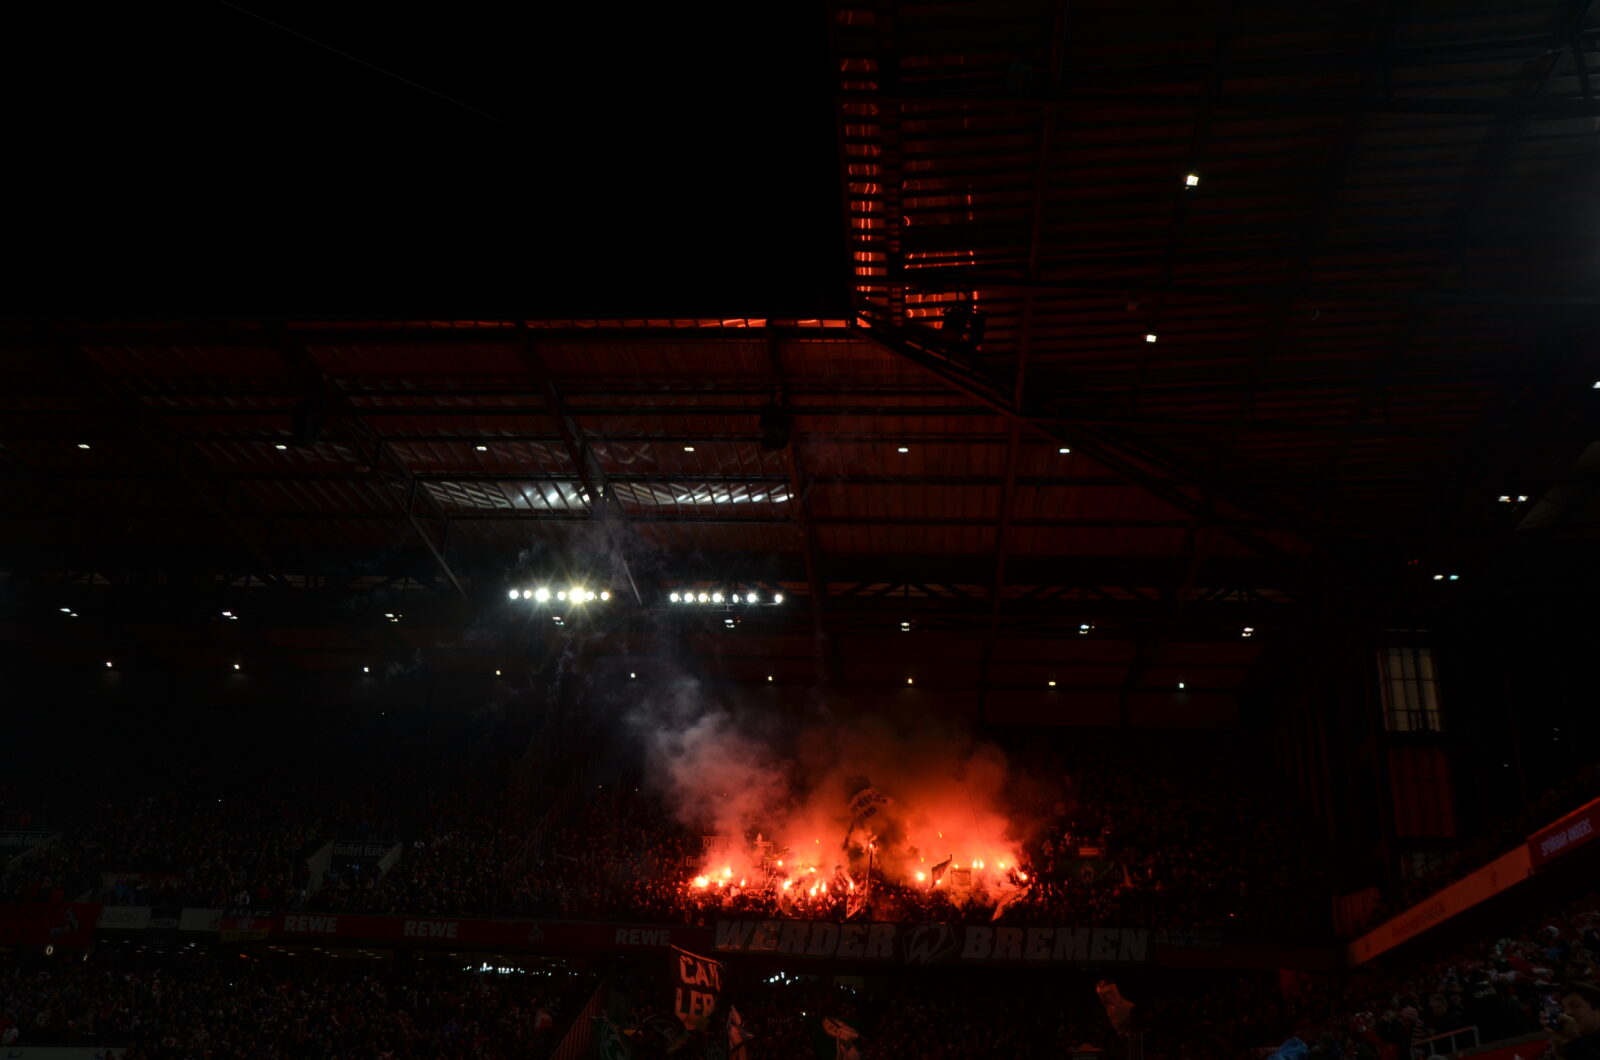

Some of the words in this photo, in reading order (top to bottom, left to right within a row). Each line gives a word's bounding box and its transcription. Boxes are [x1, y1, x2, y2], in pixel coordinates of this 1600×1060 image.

[283, 915, 338, 932] REWE
[403, 920, 458, 938] REWE
[615, 928, 672, 946] REWE
[714, 920, 896, 959] WERDER
[961, 925, 1147, 961] BREMEN
